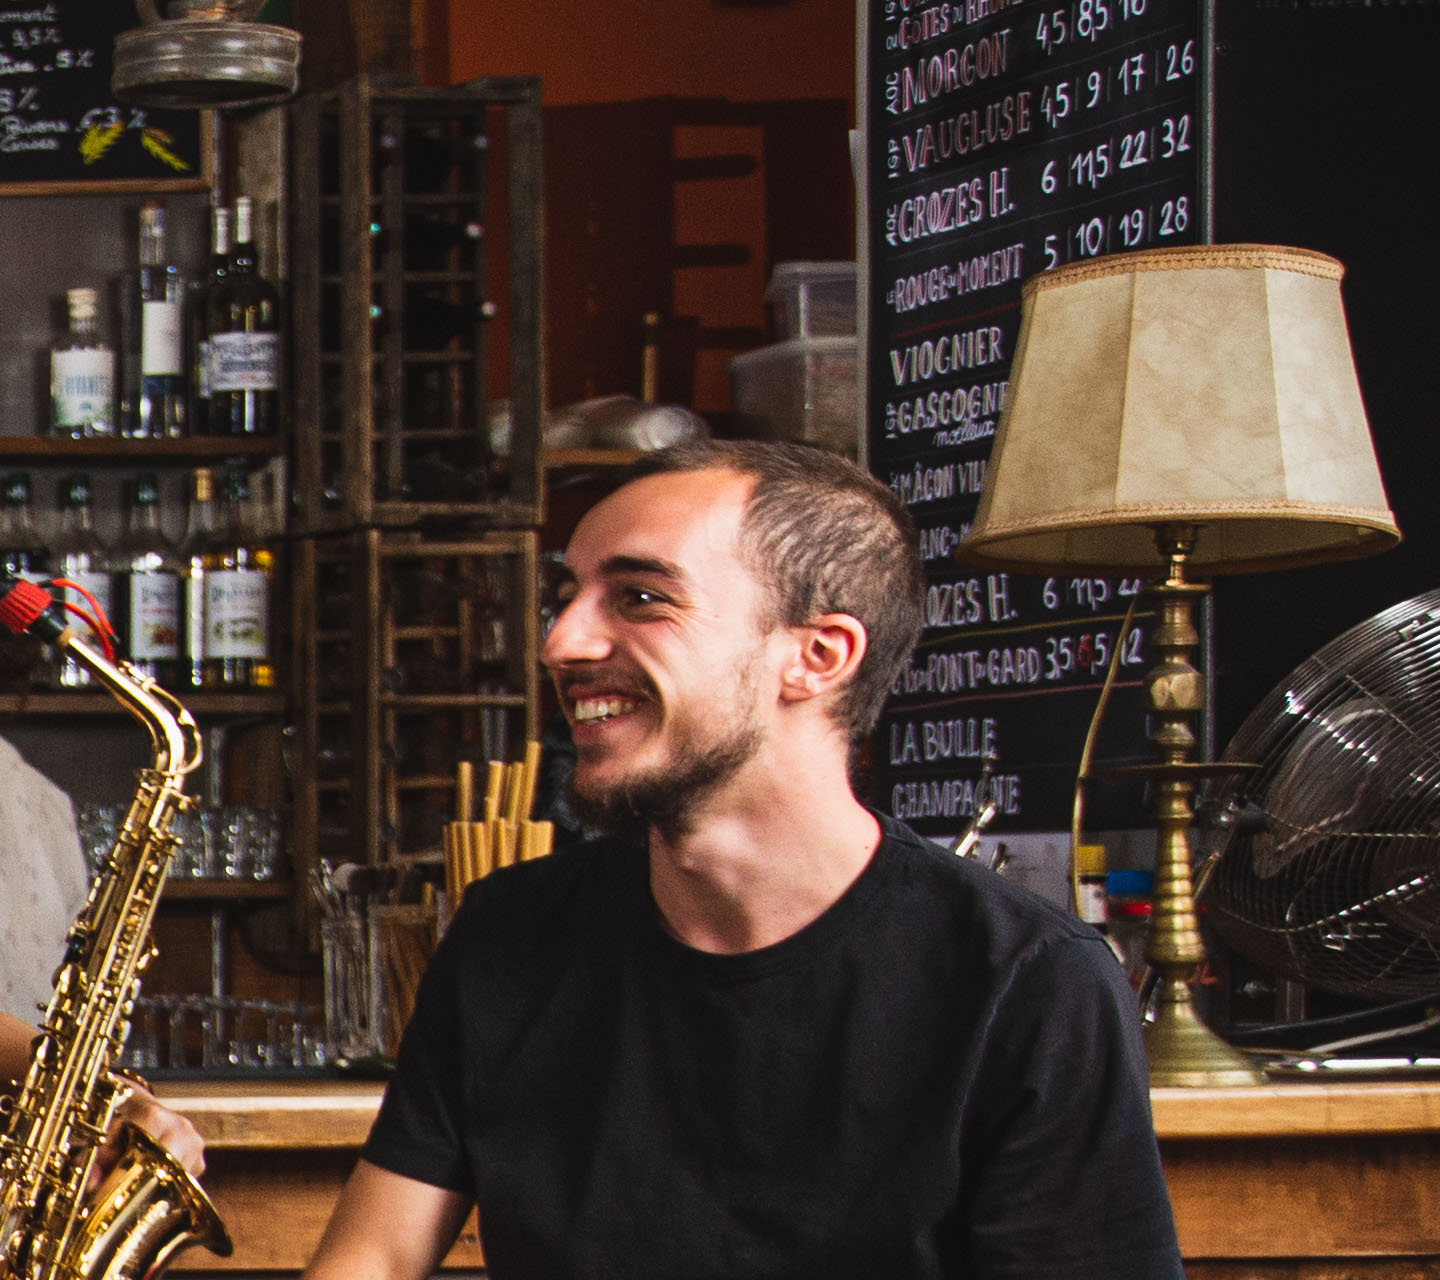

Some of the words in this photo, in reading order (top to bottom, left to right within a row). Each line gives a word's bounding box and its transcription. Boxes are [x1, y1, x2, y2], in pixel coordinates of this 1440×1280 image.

[886, 72, 900, 115] AOC
[902, 29, 1013, 112] MORGON
[1036, 9, 1066, 56] 4,5
[887, 139, 899, 178] IGP
[902, 92, 1031, 173] VAUCLUSE
[1040, 82, 1069, 128] 4,5
[1086, 71, 1101, 108] 9
[1118, 53, 1144, 95] 17
[1166, 40, 1194, 81] 26
[885, 204, 898, 246] AOC
[899, 177, 983, 242] CROZES
[990, 167, 1016, 218] H.
[1041, 161, 1057, 193] 6
[1119, 130, 1148, 169] 22
[1162, 114, 1191, 158] 32
[896, 265, 950, 313] ROUGE
[957, 242, 1024, 295] MOMENT
[1044, 235, 1060, 270] 5
[1076, 217, 1104, 256] 10
[1119, 208, 1144, 246] 19
[1159, 196, 1188, 235] 28
[890, 327, 1002, 386] VIOGNIER
[899, 461, 954, 504] MÂCON
[987, 574, 1017, 621] H.
[1043, 577, 1057, 609] 6
[927, 651, 980, 693] PONT
[987, 648, 1040, 684] GARD
[890, 722, 921, 765] LA
[923, 717, 998, 761] BULLE
